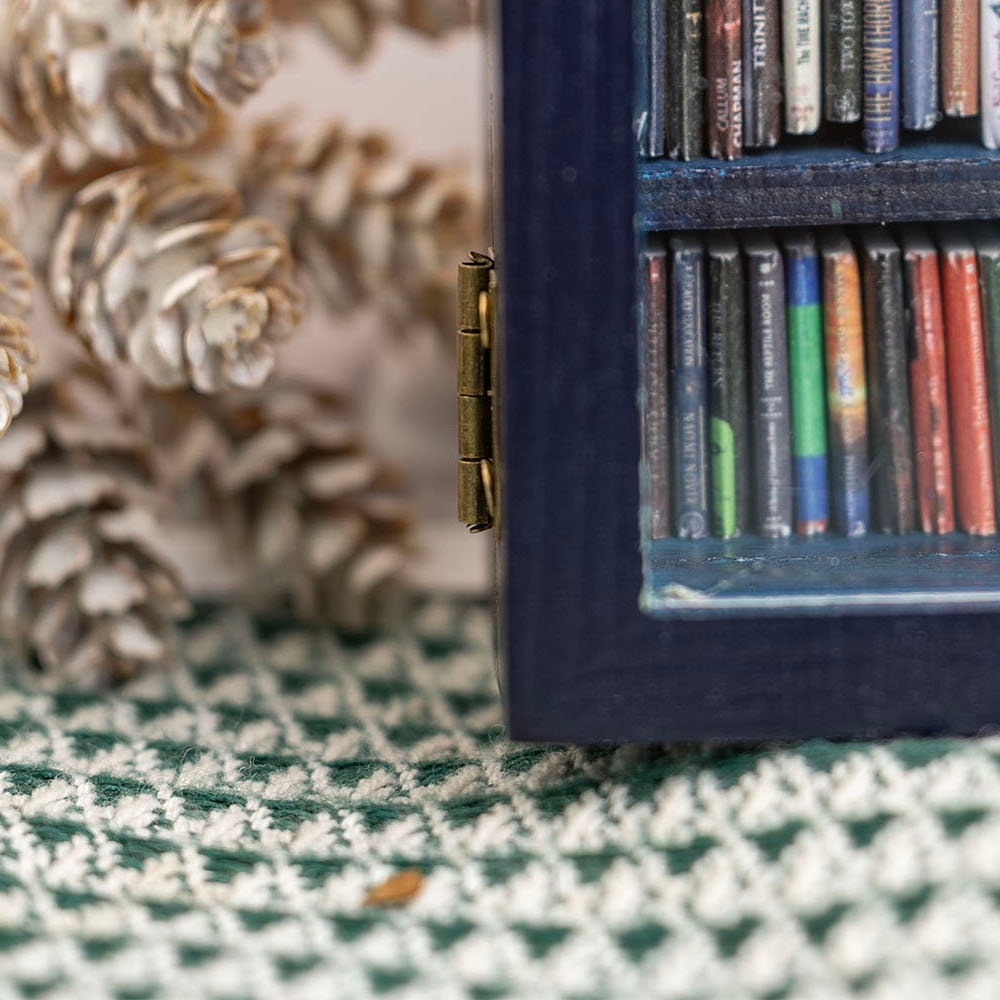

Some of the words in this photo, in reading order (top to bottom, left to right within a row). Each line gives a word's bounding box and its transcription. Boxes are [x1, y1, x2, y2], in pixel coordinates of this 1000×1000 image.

[796, 27, 810, 48] TIME
[841, 33, 856, 70] TWO
[796, 50, 810, 65] The
[953, 41, 963, 87] HOSPITAL
[715, 77, 729, 131] CALLUM
[733, 59, 742, 149] CHAPMAN
[865, 90, 893, 123] THE
[761, 294, 773, 326] ROOM
[765, 368, 775, 390] THE
[683, 411, 696, 458] NAOMI
[684, 461, 697, 505] NOVIK
